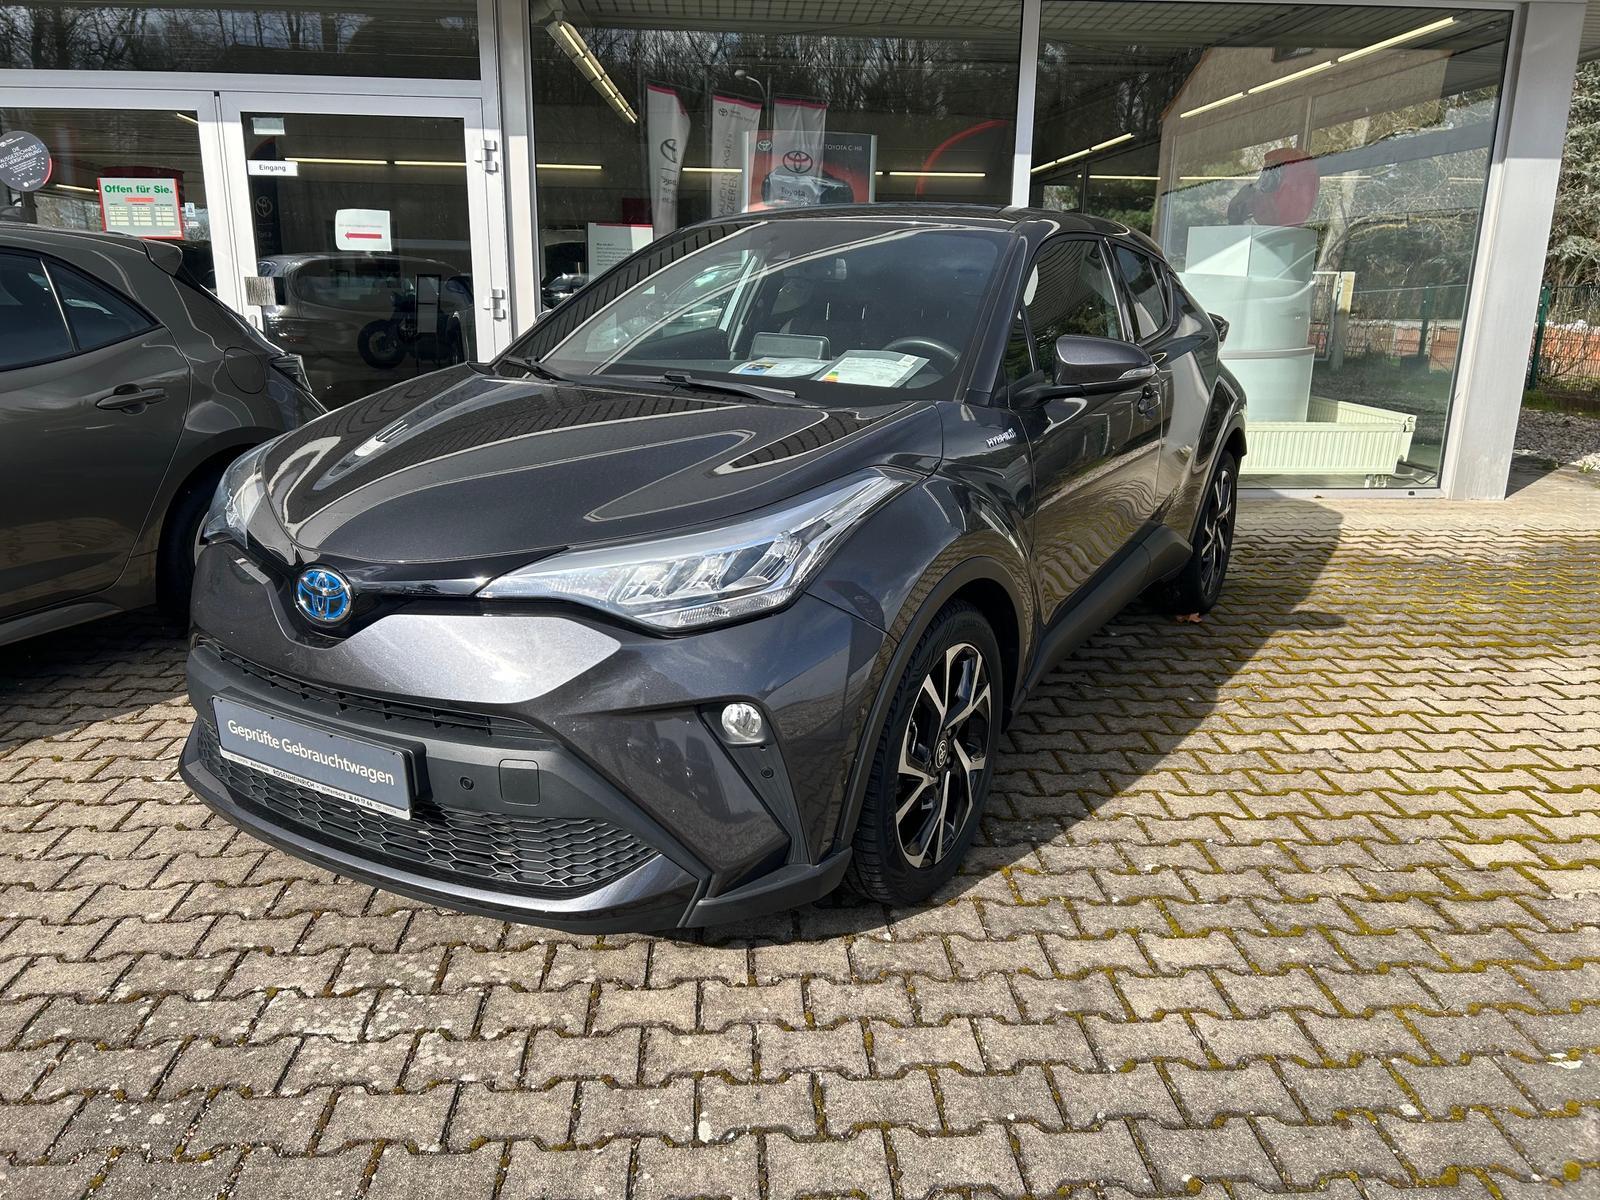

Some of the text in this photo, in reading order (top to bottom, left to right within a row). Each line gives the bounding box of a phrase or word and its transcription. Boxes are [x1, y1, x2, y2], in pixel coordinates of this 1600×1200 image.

[825, 143, 847, 151] TOYOTA
[258, 164, 286, 172] Eingang
[104, 185, 173, 194] Offen für Sie.
[781, 187, 806, 197] Toyota
[228, 719, 395, 786] Geprüfte Gebrauchtwagen
[273, 769, 315, 788] ROSENHEINRICH
